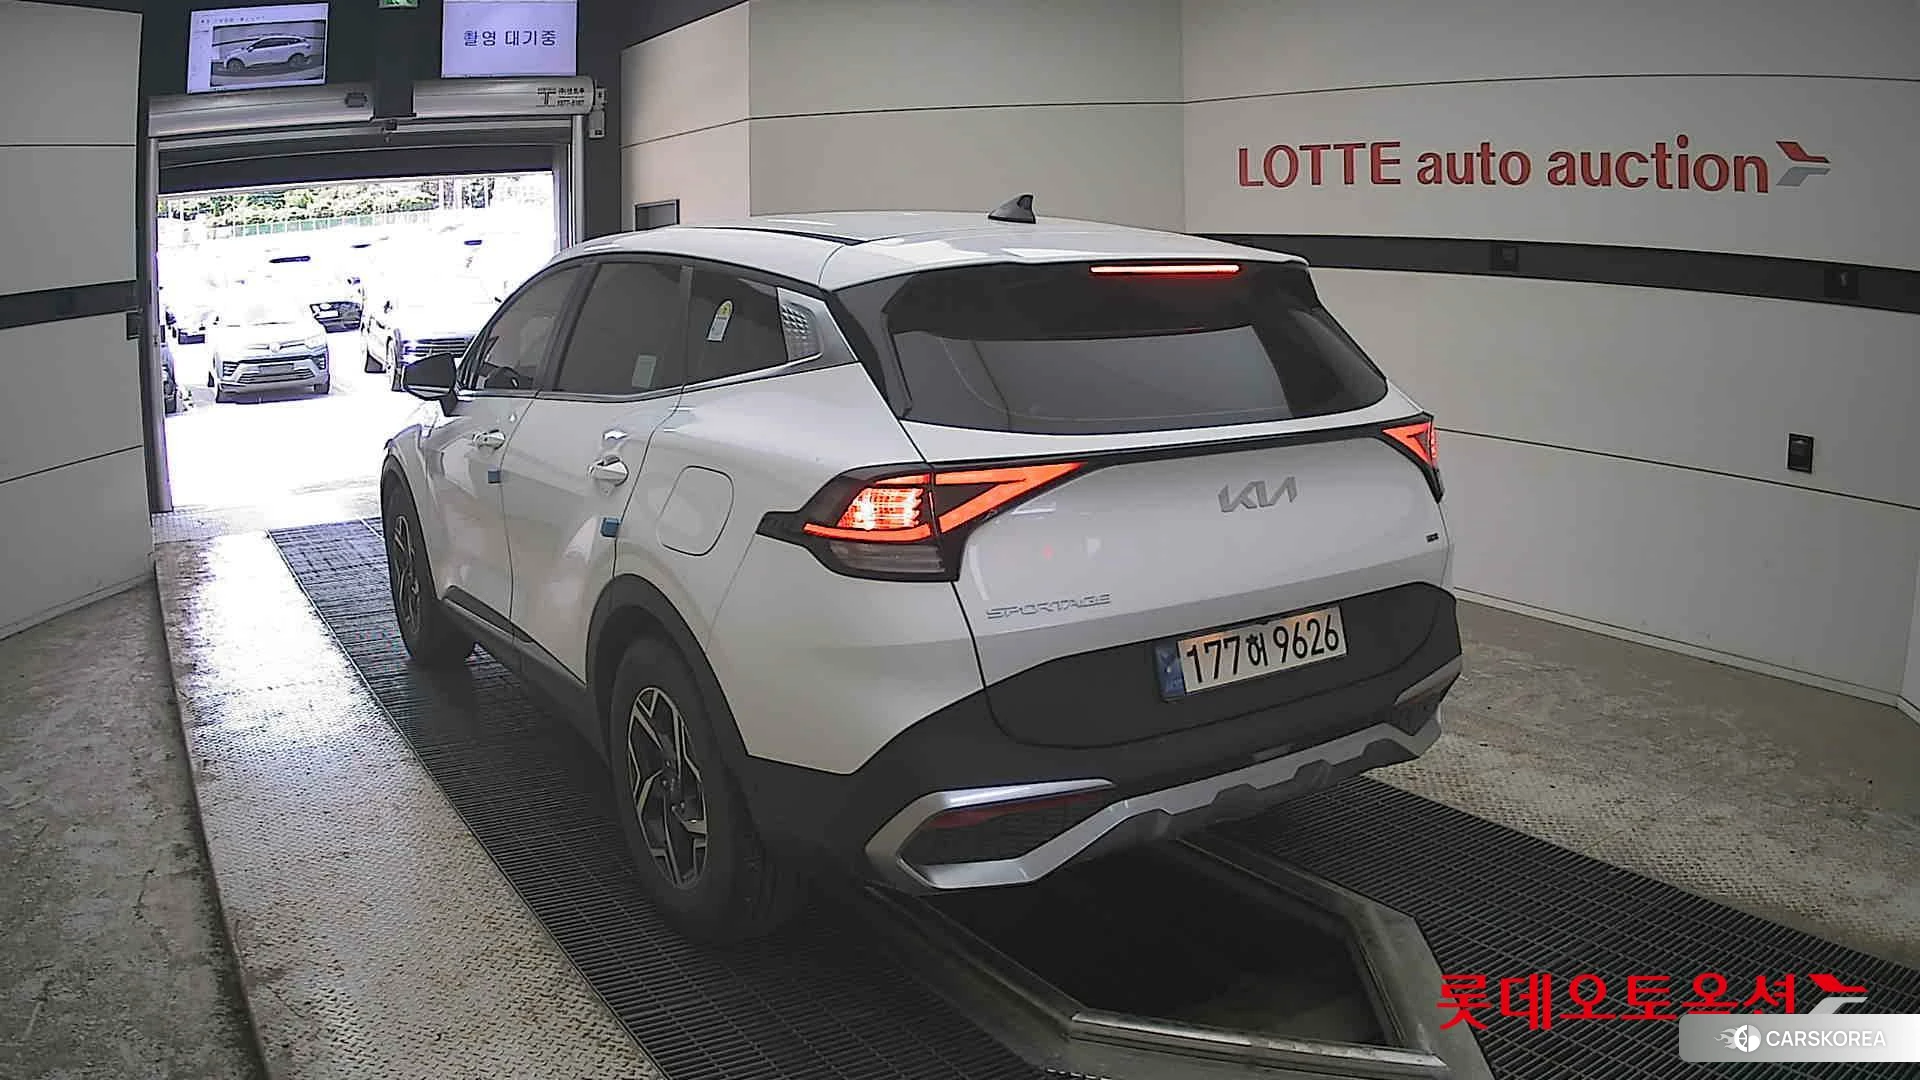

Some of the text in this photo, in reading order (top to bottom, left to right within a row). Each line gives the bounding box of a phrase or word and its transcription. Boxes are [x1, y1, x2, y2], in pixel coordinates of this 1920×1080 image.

[464, 30, 556, 47] 촬영 대기중
[1238, 134, 1769, 194] LOTTE auto auction
[1217, 476, 1298, 513] KIA
[986, 593, 1111, 620] SPORTAGE
